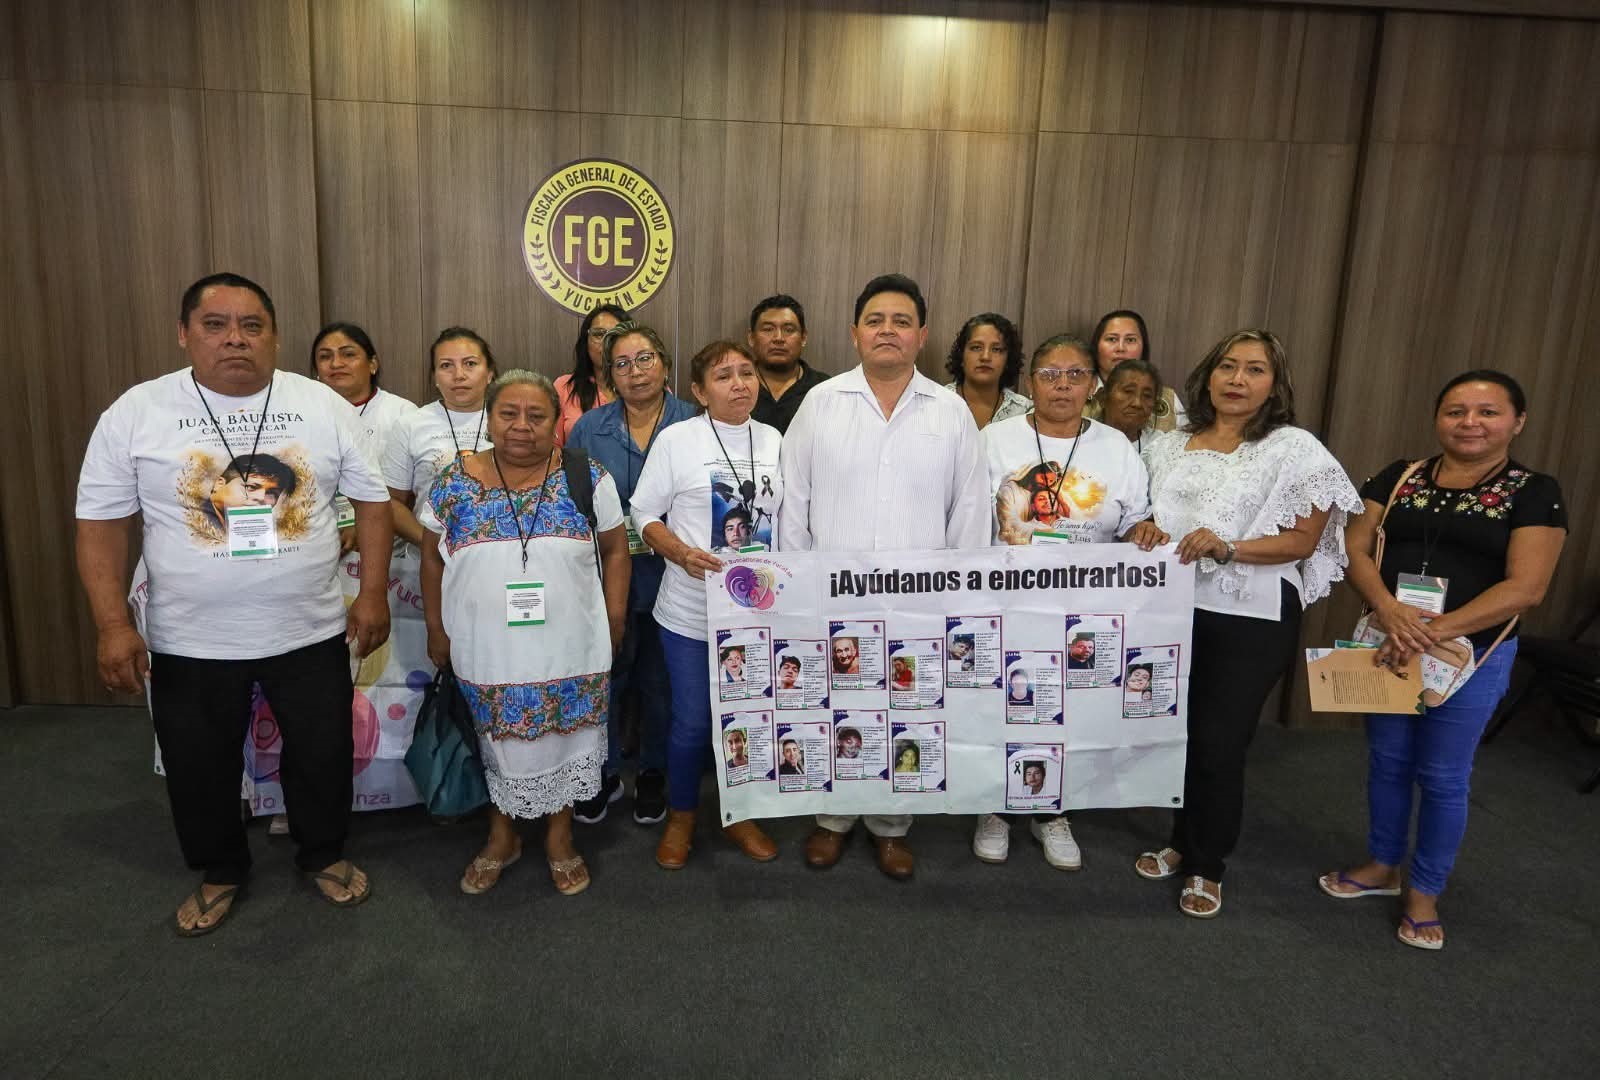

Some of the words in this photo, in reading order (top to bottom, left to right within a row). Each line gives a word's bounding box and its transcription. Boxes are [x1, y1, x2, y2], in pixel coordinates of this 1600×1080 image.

[531, 179, 567, 226] FISCALÍA
[565, 167, 616, 187] GENERAL
[618, 173, 640, 194] DEL
[637, 188, 667, 231] ESTADO
[564, 215, 635, 266] FGE
[178, 416, 221, 430] JUAN
[228, 413, 304, 425] BAUTISTA
[830, 568, 961, 598] ¡Ayúdanos
[967, 570, 982, 591] a
[988, 561, 1166, 591] encontrarlos!
